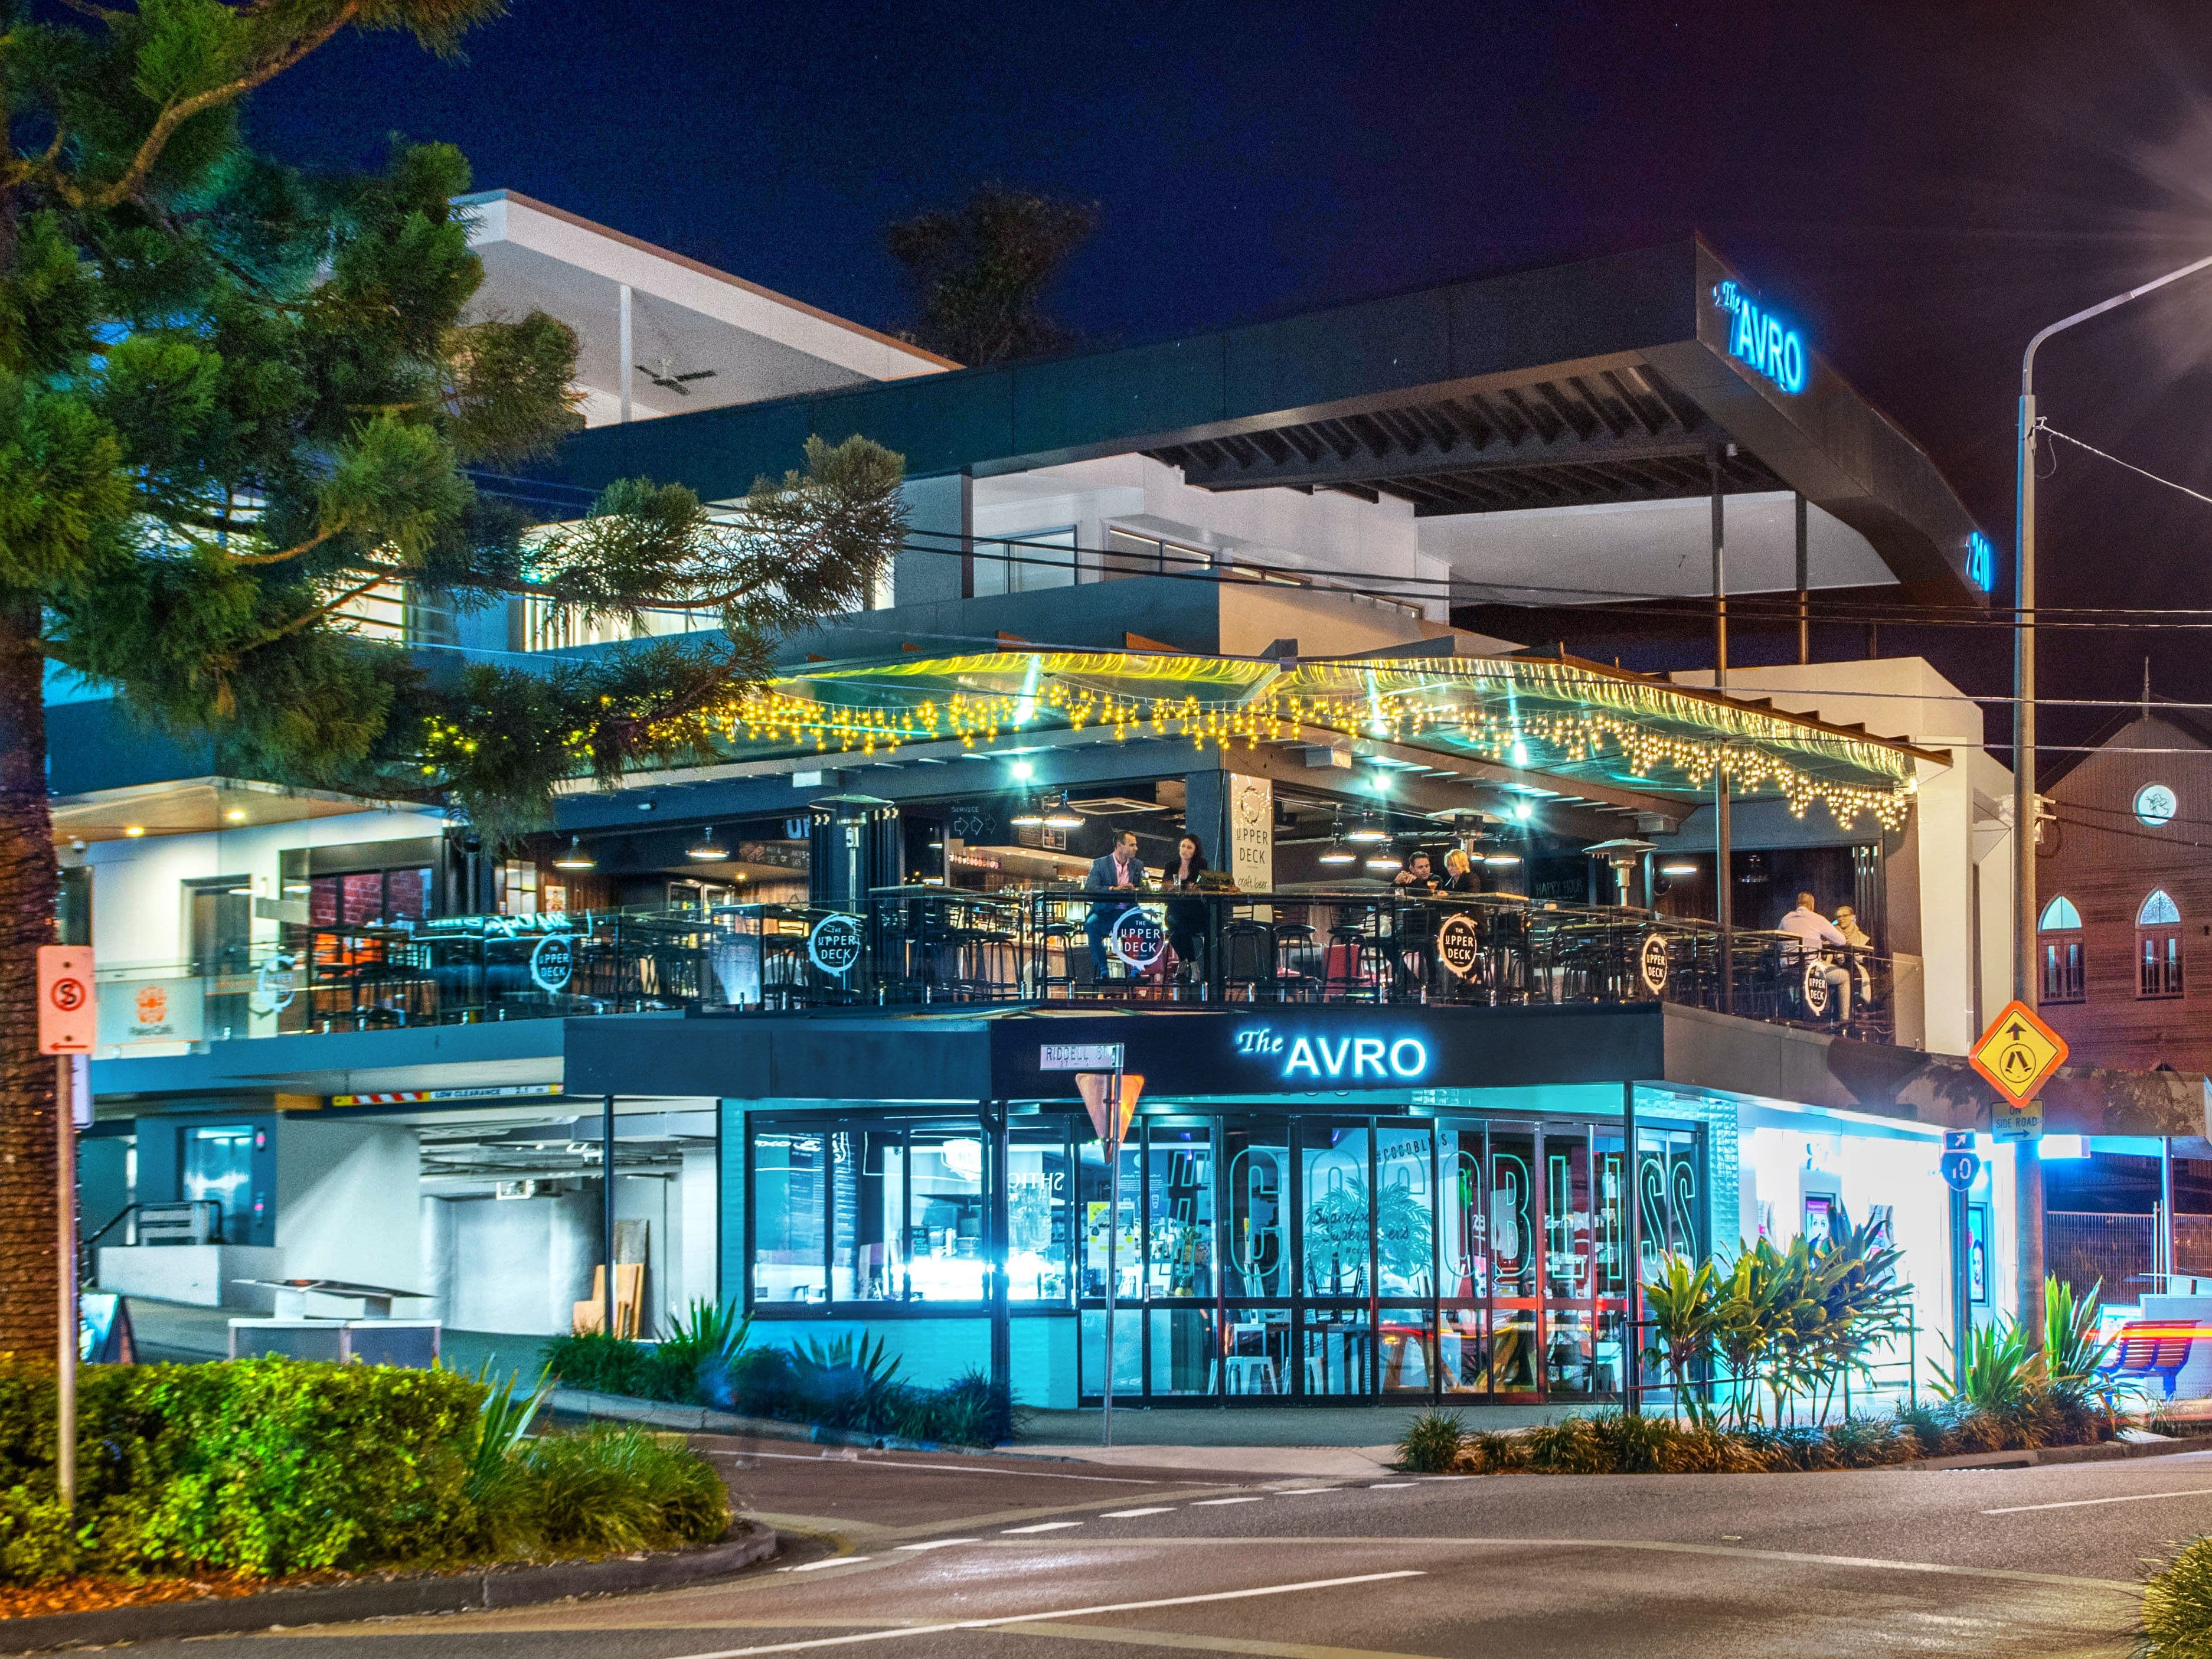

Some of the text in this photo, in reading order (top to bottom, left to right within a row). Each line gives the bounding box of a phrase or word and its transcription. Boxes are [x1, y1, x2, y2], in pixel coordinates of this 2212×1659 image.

[1723, 282, 1740, 313] The
[1739, 299, 1802, 394] AVRO
[1236, 828, 1268, 845] UPPER
[1240, 847, 1265, 864] DECK
[1238, 875, 1268, 890] craft beer
[1536, 880, 1560, 897] HAPPY
[1121, 928, 1161, 939] UPPER
[818, 935, 855, 946] UPPER
[1445, 935, 1473, 947] UPPER
[1125, 942, 1156, 952] DECK
[821, 949, 851, 959] DECK
[1448, 948, 1471, 960] DECK
[1646, 954, 1665, 965] UPPER
[541, 966, 566, 977] DECK
[1648, 966, 1664, 978] DECK
[1811, 989, 1824, 1000] DECK
[1237, 1028, 1283, 1053] The
[1047, 1047, 1089, 1060] RIDDELL
[1283, 1037, 1426, 1077] AVRO
[454, 1089, 501, 1097] CLEARANCE
[1996, 1116, 2037, 1128] SIDE ROAD
